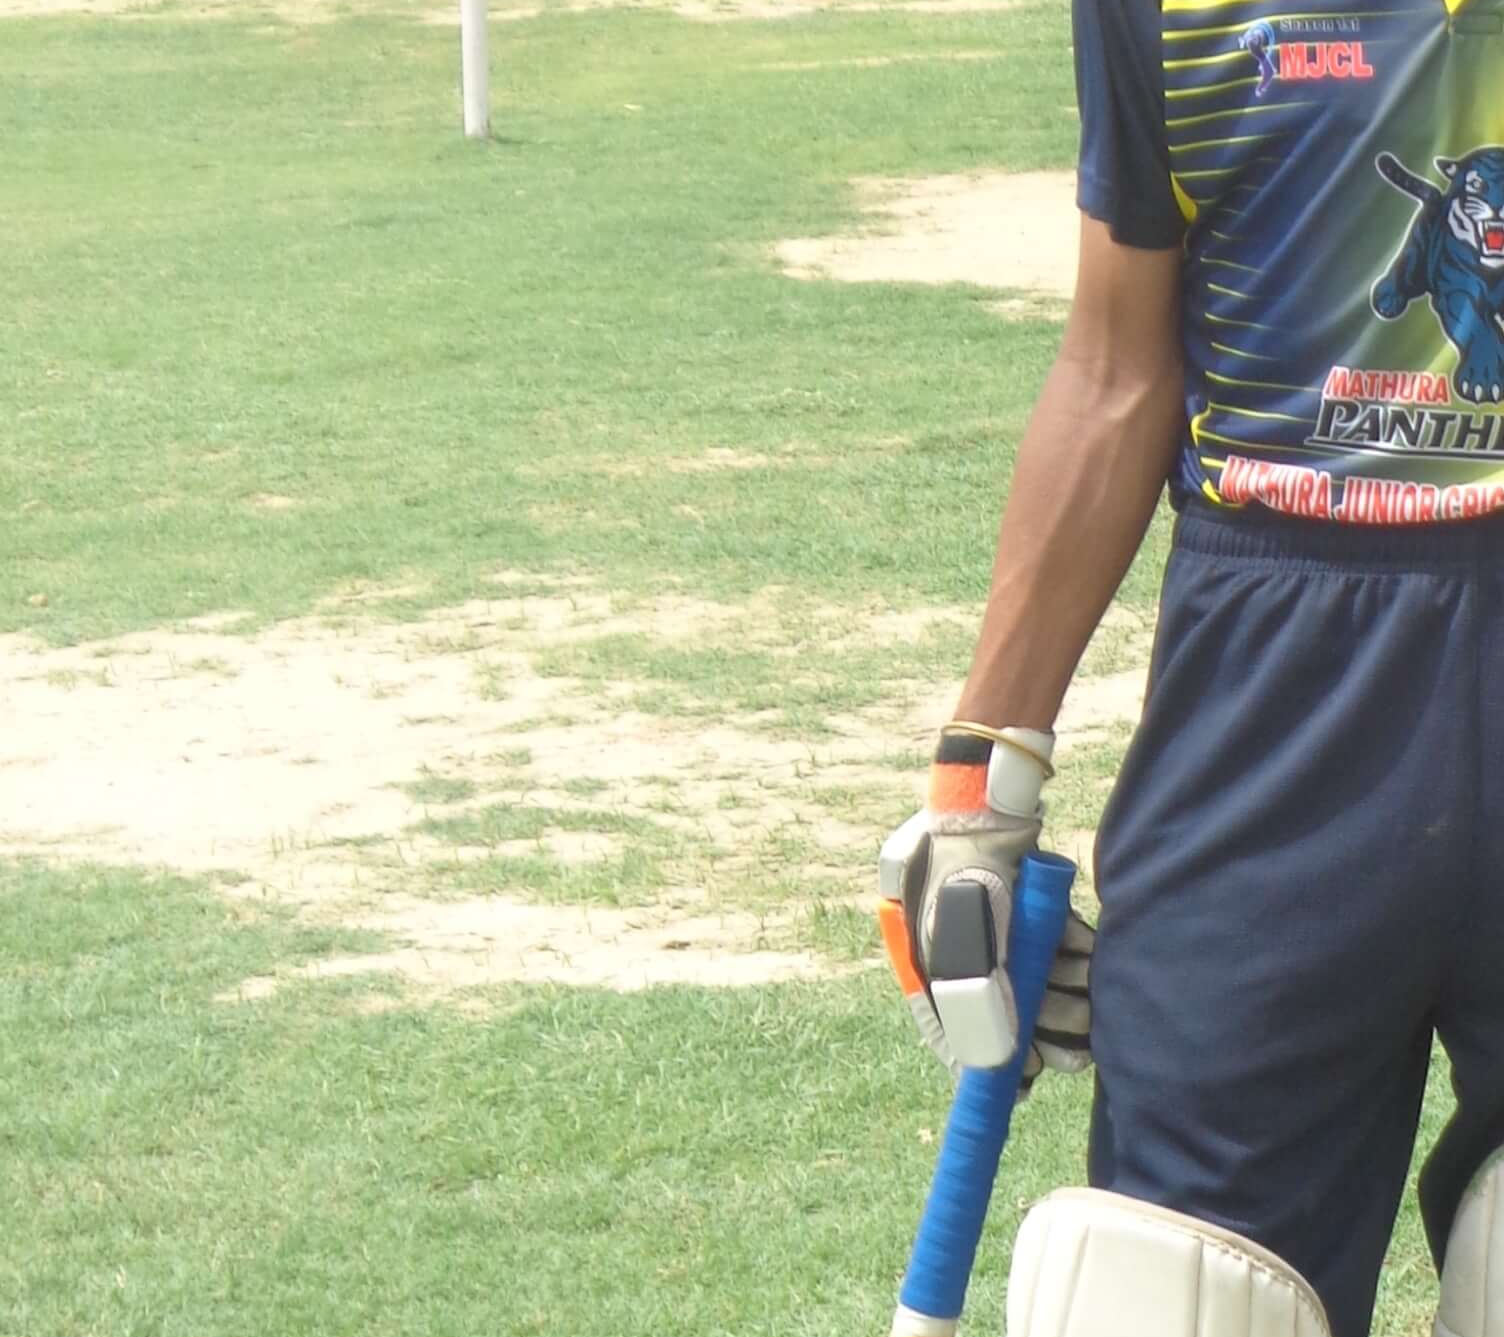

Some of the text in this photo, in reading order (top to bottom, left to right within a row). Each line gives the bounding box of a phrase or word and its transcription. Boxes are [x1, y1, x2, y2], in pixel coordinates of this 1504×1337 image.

[1279, 40, 1375, 81] MJCL
[1323, 366, 1451, 404] MATHURA
[1334, 475, 1440, 524] JUNIOR
